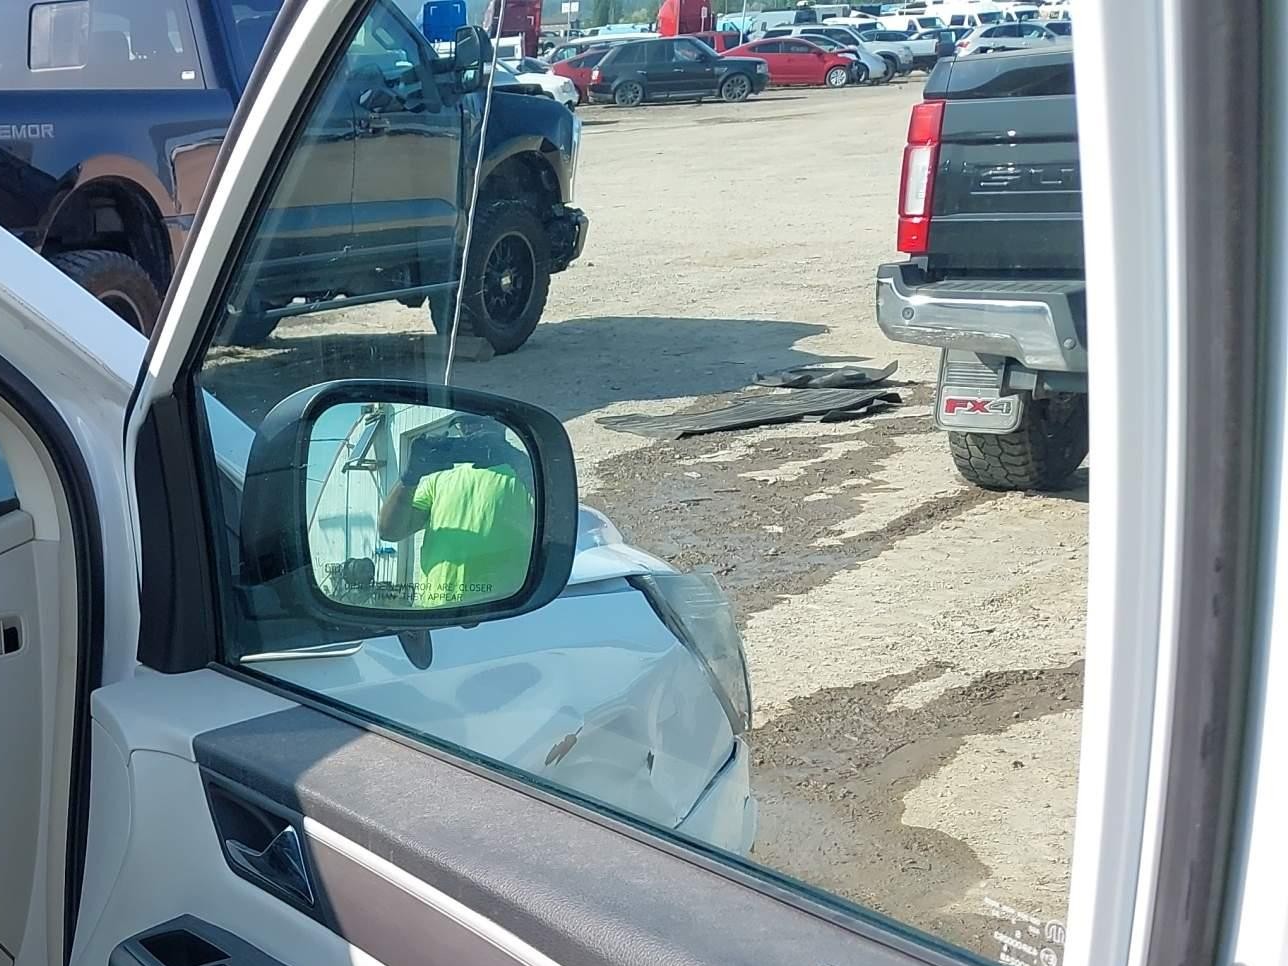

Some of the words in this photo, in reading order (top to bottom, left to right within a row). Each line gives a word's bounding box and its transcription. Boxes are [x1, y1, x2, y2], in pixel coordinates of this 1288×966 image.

[944, 396, 1013, 416] FX4
[436, 582, 453, 591] ARE
[458, 583, 493, 592] CLOSER
[427, 592, 464, 602] APPEAR
